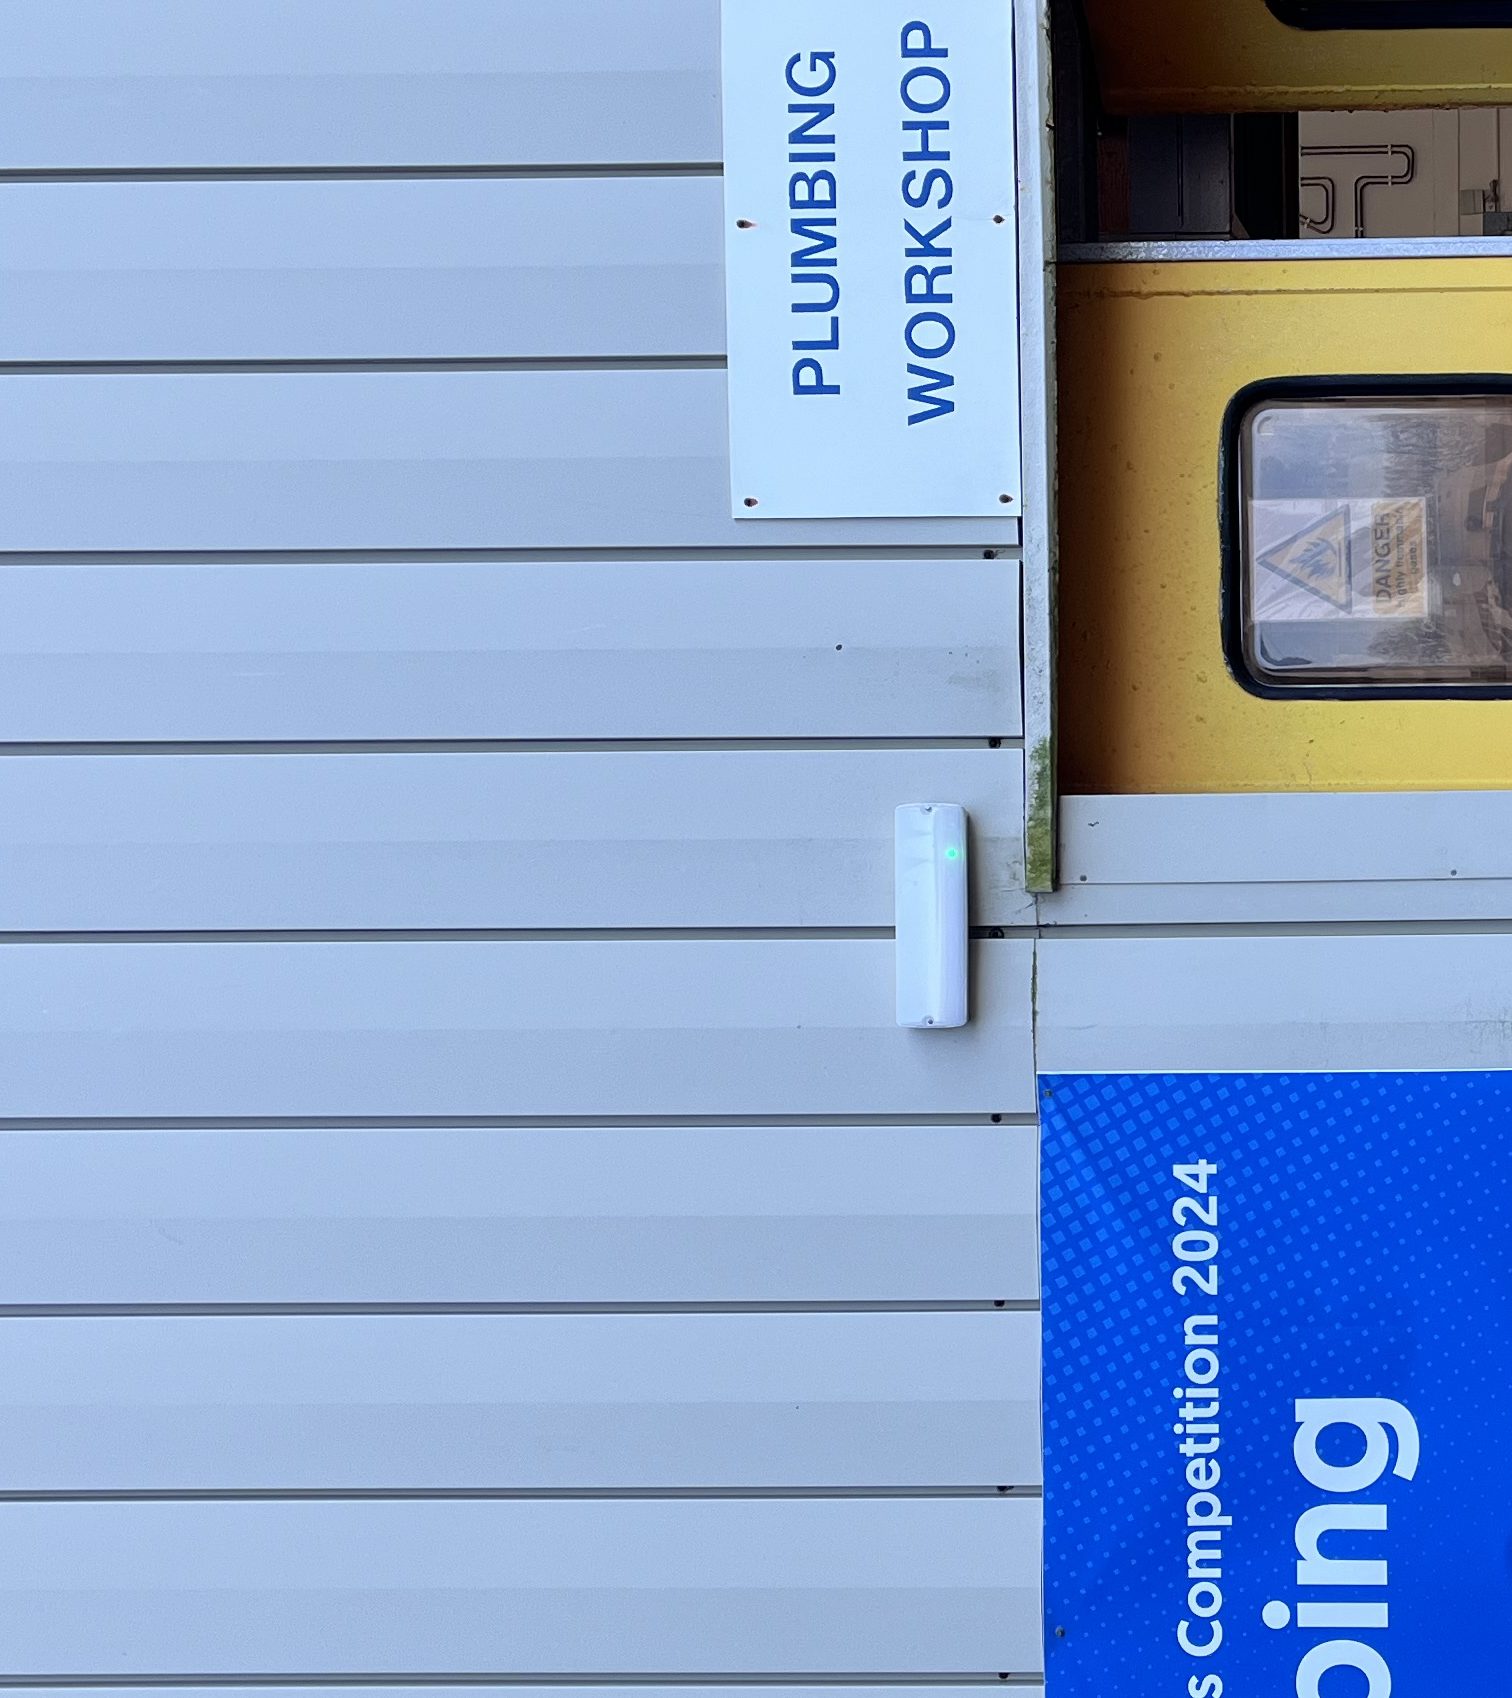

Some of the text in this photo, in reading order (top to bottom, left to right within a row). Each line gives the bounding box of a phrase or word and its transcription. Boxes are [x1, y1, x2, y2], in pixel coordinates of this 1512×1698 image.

[786, 52, 840, 395] PLUMBING
[900, 21, 955, 426] WORKSHOP
[1375, 513, 1392, 603] DANGER
[1173, 1159, 1218, 1295] 2024
[1173, 1316, 1232, 1656] Competition
